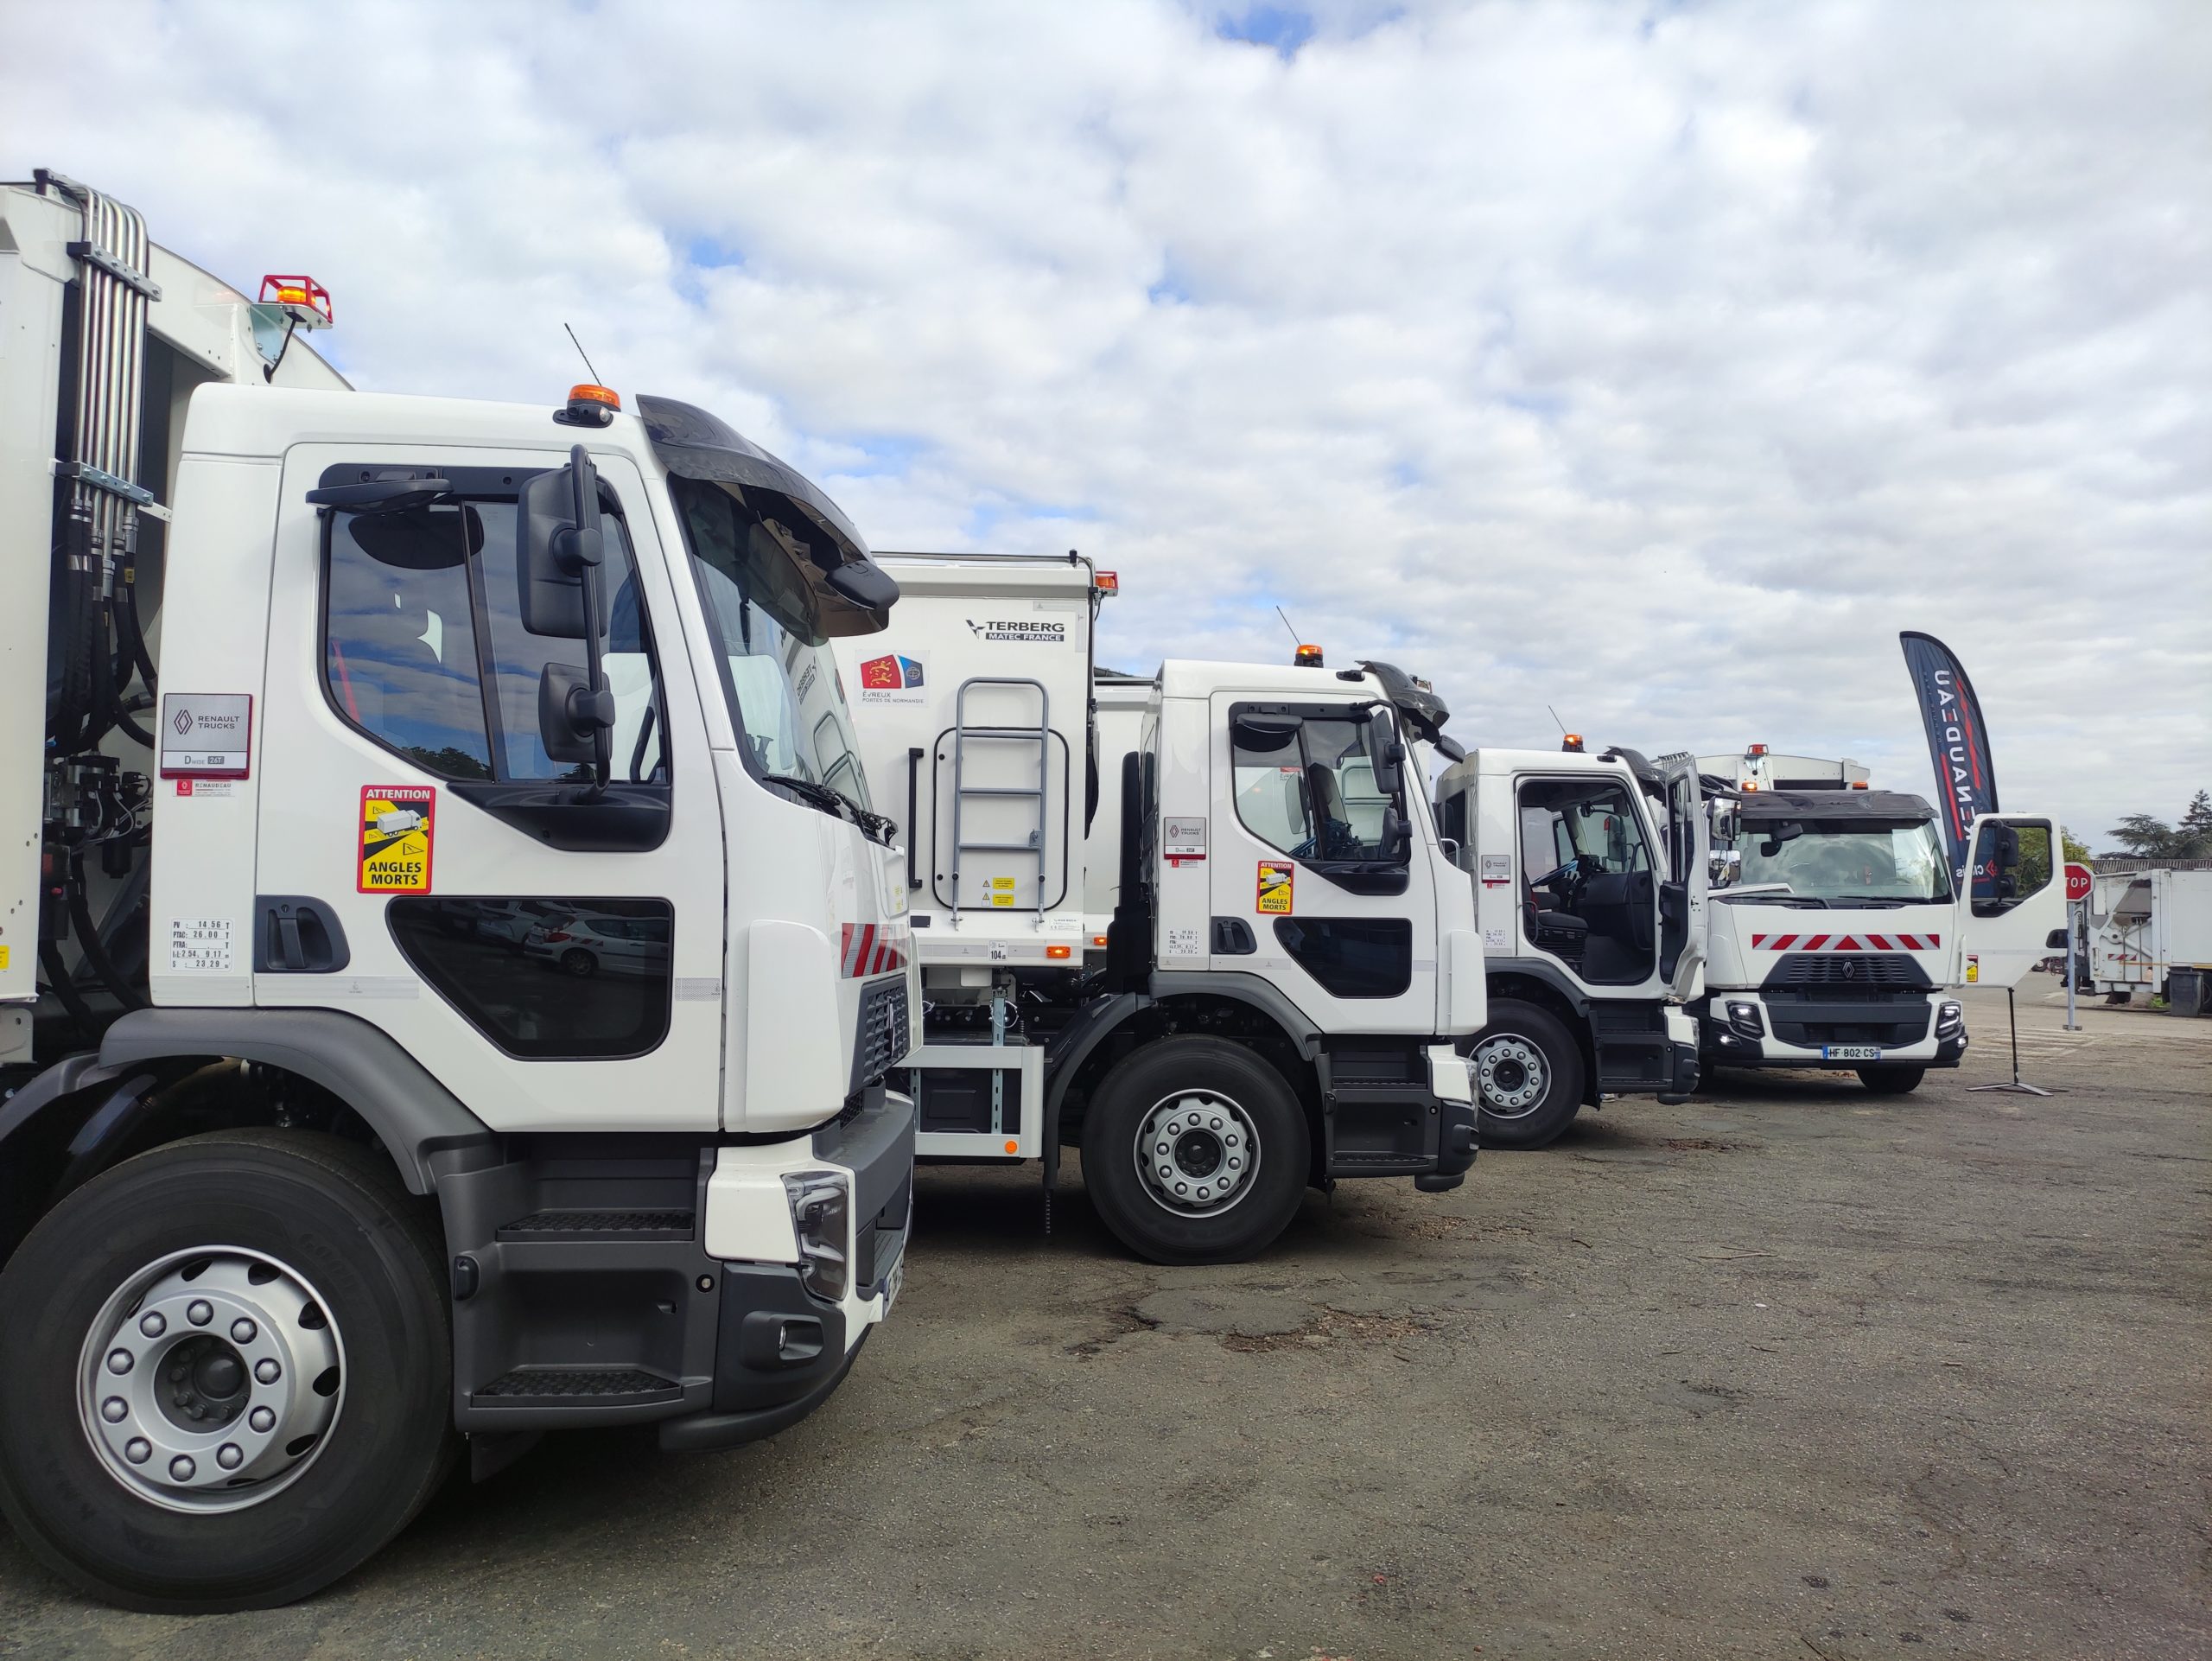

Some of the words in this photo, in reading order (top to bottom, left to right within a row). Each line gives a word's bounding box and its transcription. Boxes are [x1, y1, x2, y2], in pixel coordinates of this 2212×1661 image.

[985, 621, 1065, 633] TERBERG
[365, 789, 430, 799] ATTENTION
[368, 862, 422, 873] ANGLES
[371, 874, 419, 886] MORTS
[990, 950, 1001, 960] 104
[1843, 1048, 1861, 1058] 802
[1863, 1048, 1875, 1058] CS
